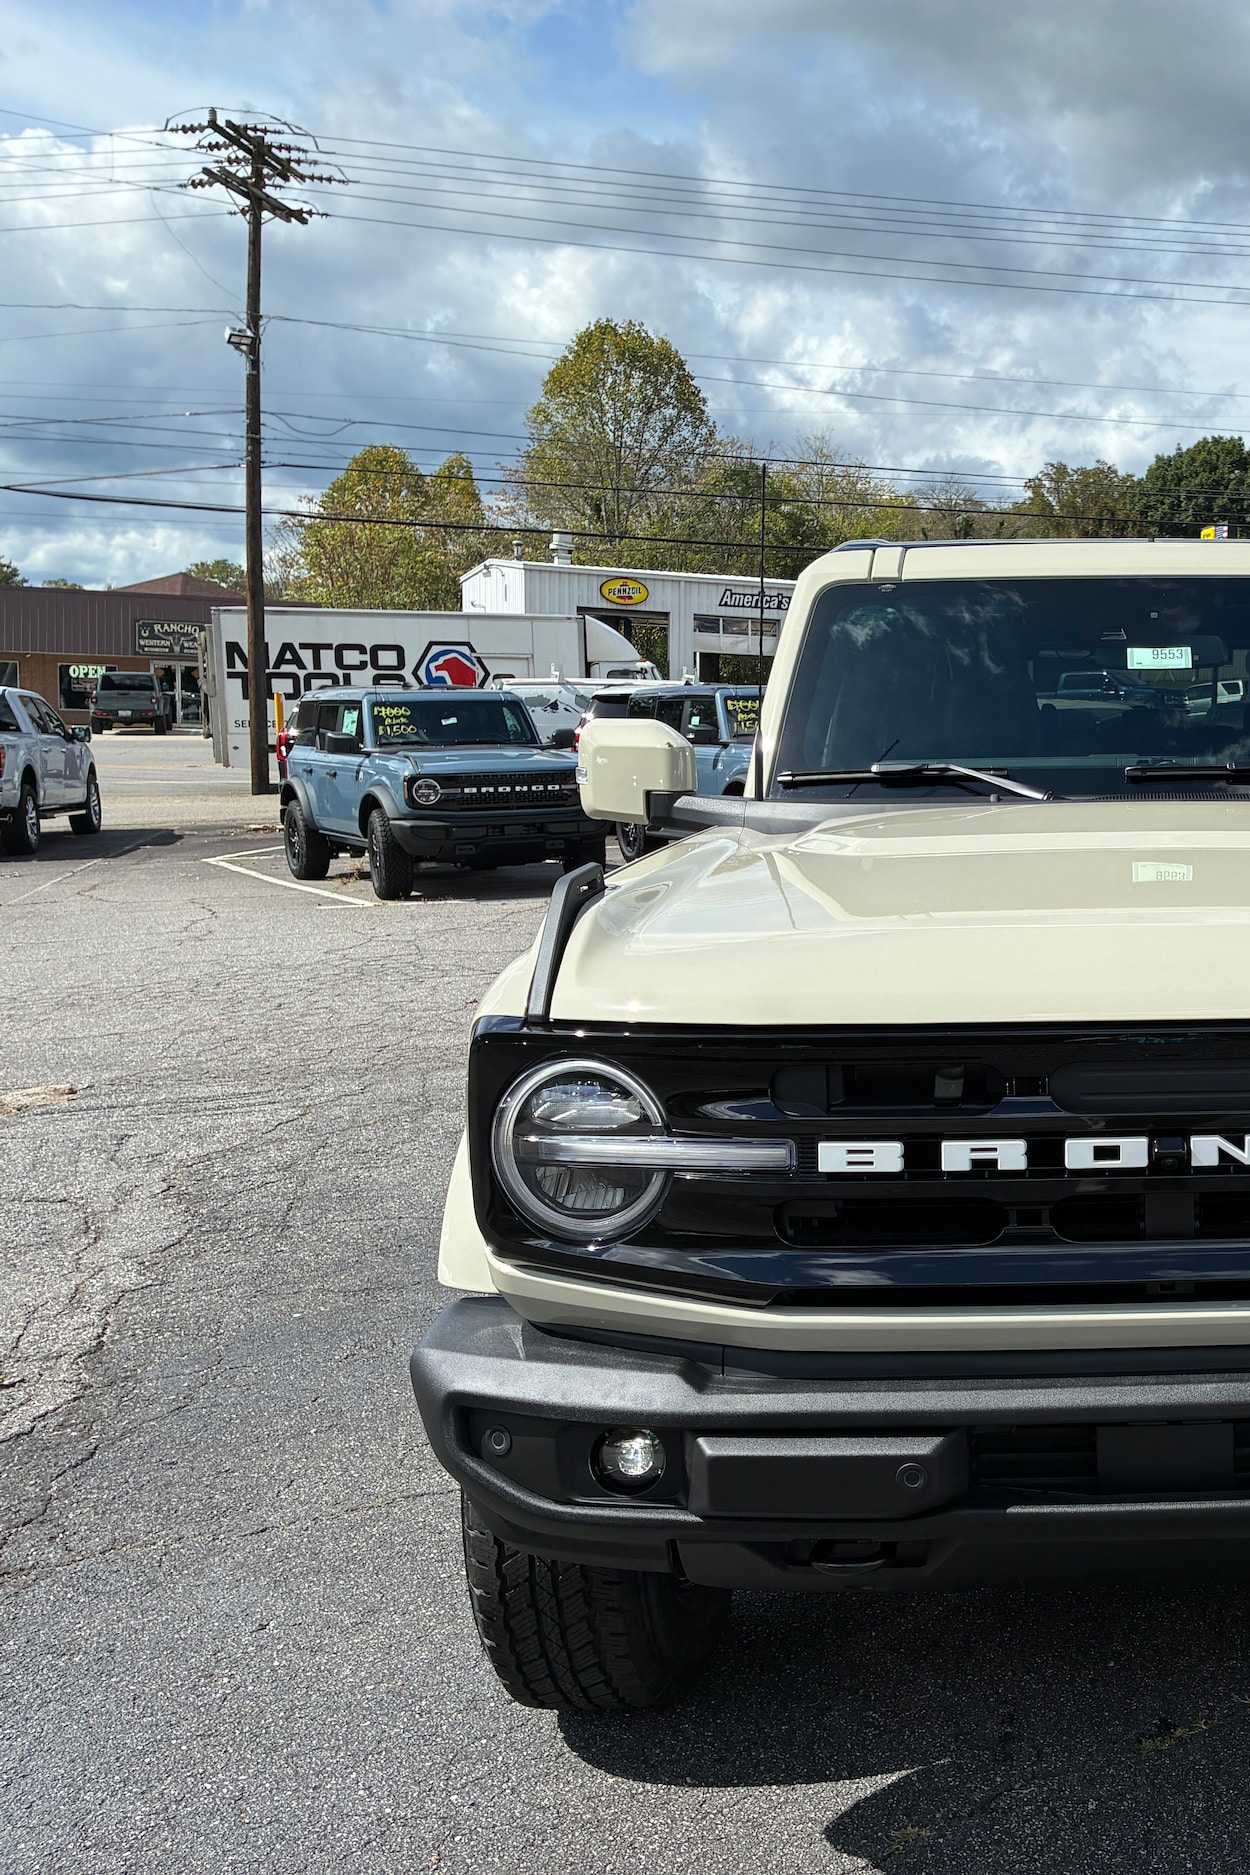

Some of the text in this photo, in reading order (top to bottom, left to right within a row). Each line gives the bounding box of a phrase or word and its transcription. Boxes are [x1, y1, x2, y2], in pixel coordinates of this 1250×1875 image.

[607, 587, 643, 597] PENNZOIL
[721, 590, 790, 609] America's
[154, 623, 200, 634] RANCHO
[139, 639, 171, 647] WESTERN
[225, 641, 406, 672] MATCO
[1152, 648, 1184, 660] 9553
[69, 665, 106, 679] OPEN
[463, 784, 560, 794] BRONCO
